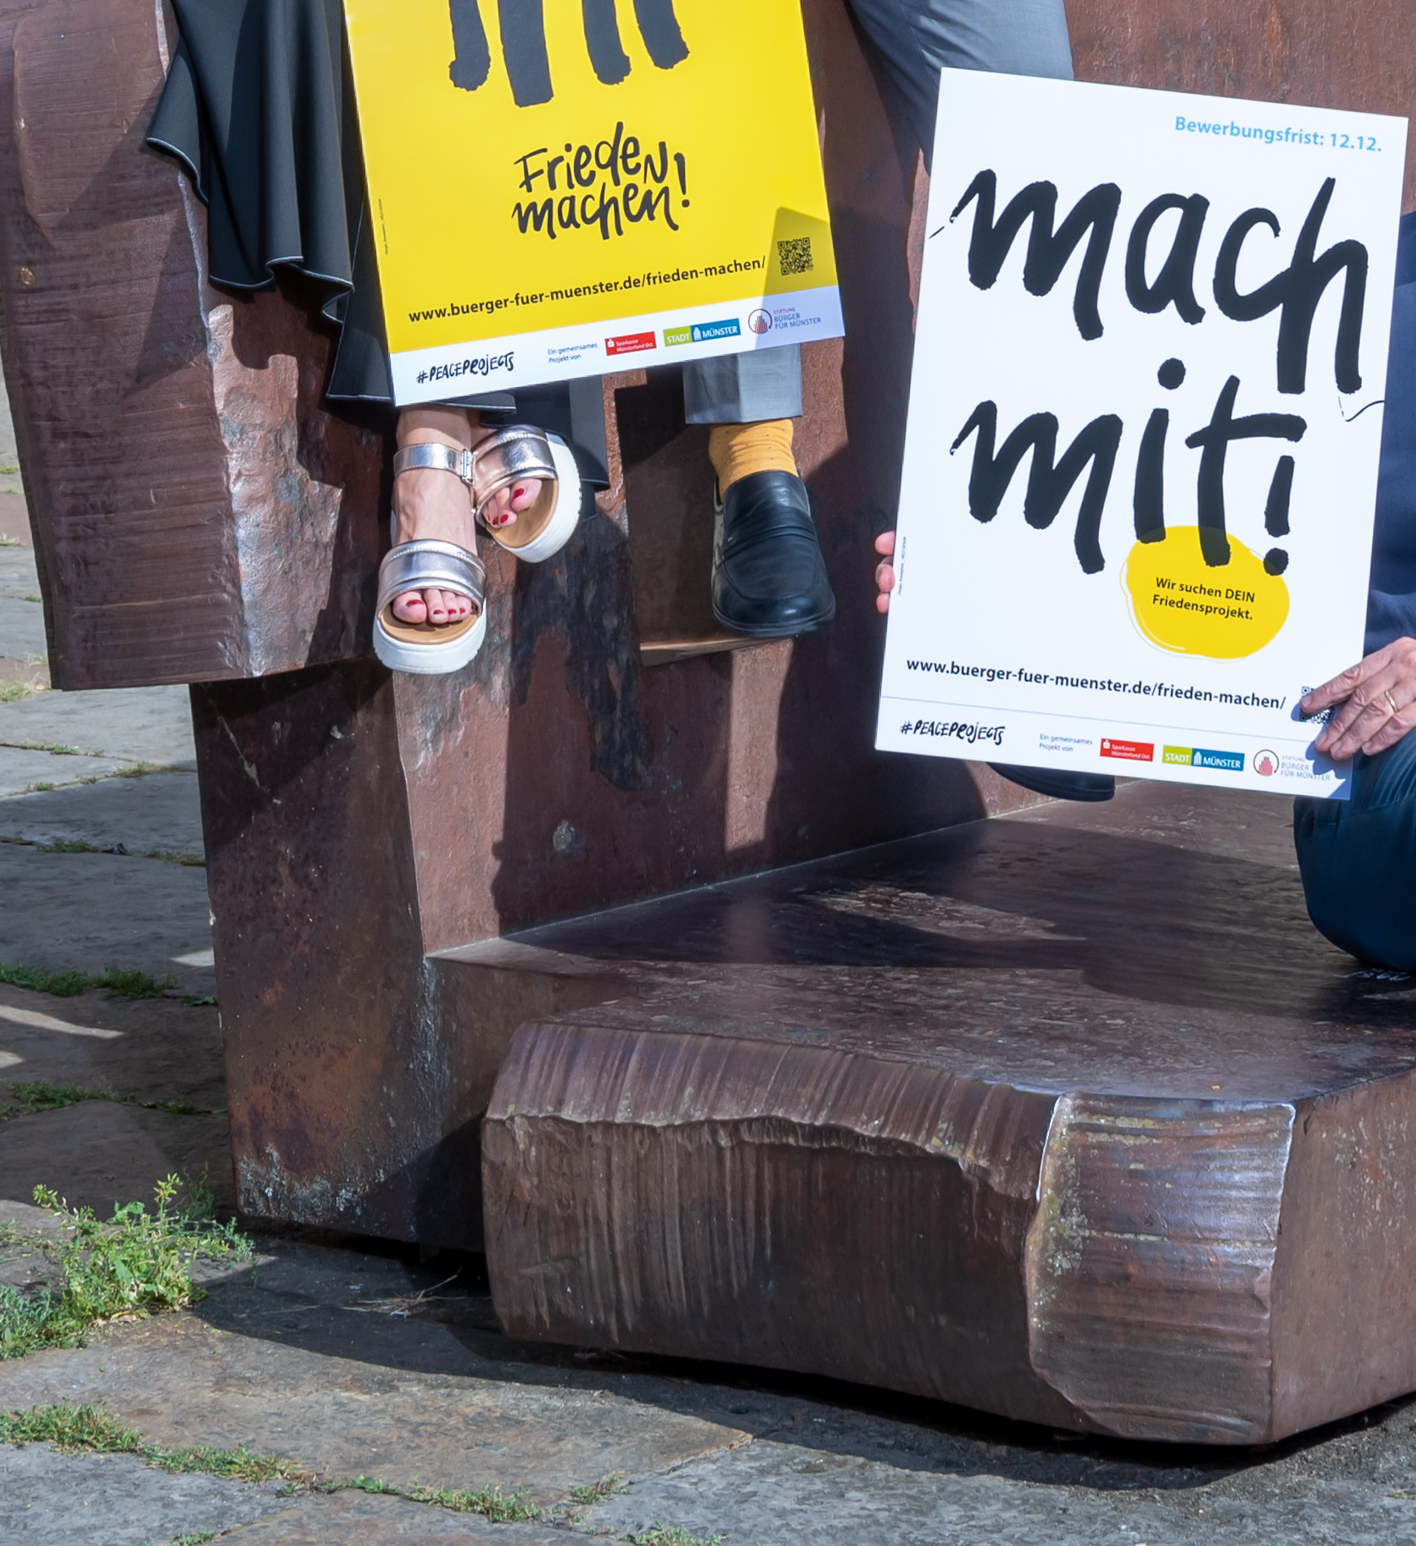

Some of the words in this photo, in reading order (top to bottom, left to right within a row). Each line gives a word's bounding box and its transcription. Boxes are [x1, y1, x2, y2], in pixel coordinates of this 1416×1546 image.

[1175, 116, 1324, 145] Bewerbungsfrist:
[1330, 133, 1382, 152] 12.12.
[511, 152, 690, 240] machen!
[408, 255, 766, 323] www.buerger-fuer-muenster.de/frieden-machen/
[950, 168, 1368, 394] mach
[773, 312, 801, 323] BÜRGER
[774, 321, 789, 330] FÜR
[789, 317, 822, 328] MÜNSTER
[666, 333, 690, 344] STADT
[702, 324, 738, 339] MÜNSTER
[547, 348, 557, 356] Ein
[558, 343, 598, 355] gemeinsames
[548, 355, 569, 364] Projekt
[950, 358, 1308, 576] mit!
[1155, 577, 1177, 590] Wir
[1178, 583, 1222, 598] suchen
[1225, 588, 1256, 603] DEIN
[1152, 594, 1253, 620] Friedensprojekt.
[906, 659, 1286, 711] www.buerger-fuer-muenster.de/frieden-machen/
[1039, 733, 1050, 741] Ein
[1050, 735, 1093, 745] gemeinsames
[1039, 743, 1061, 751] Projekt
[1165, 752, 1190, 763] STADT
[1203, 756, 1241, 769] MÜNSTER
[1280, 761, 1310, 771] BÜRGER
[1280, 769, 1296, 777] FÜR
